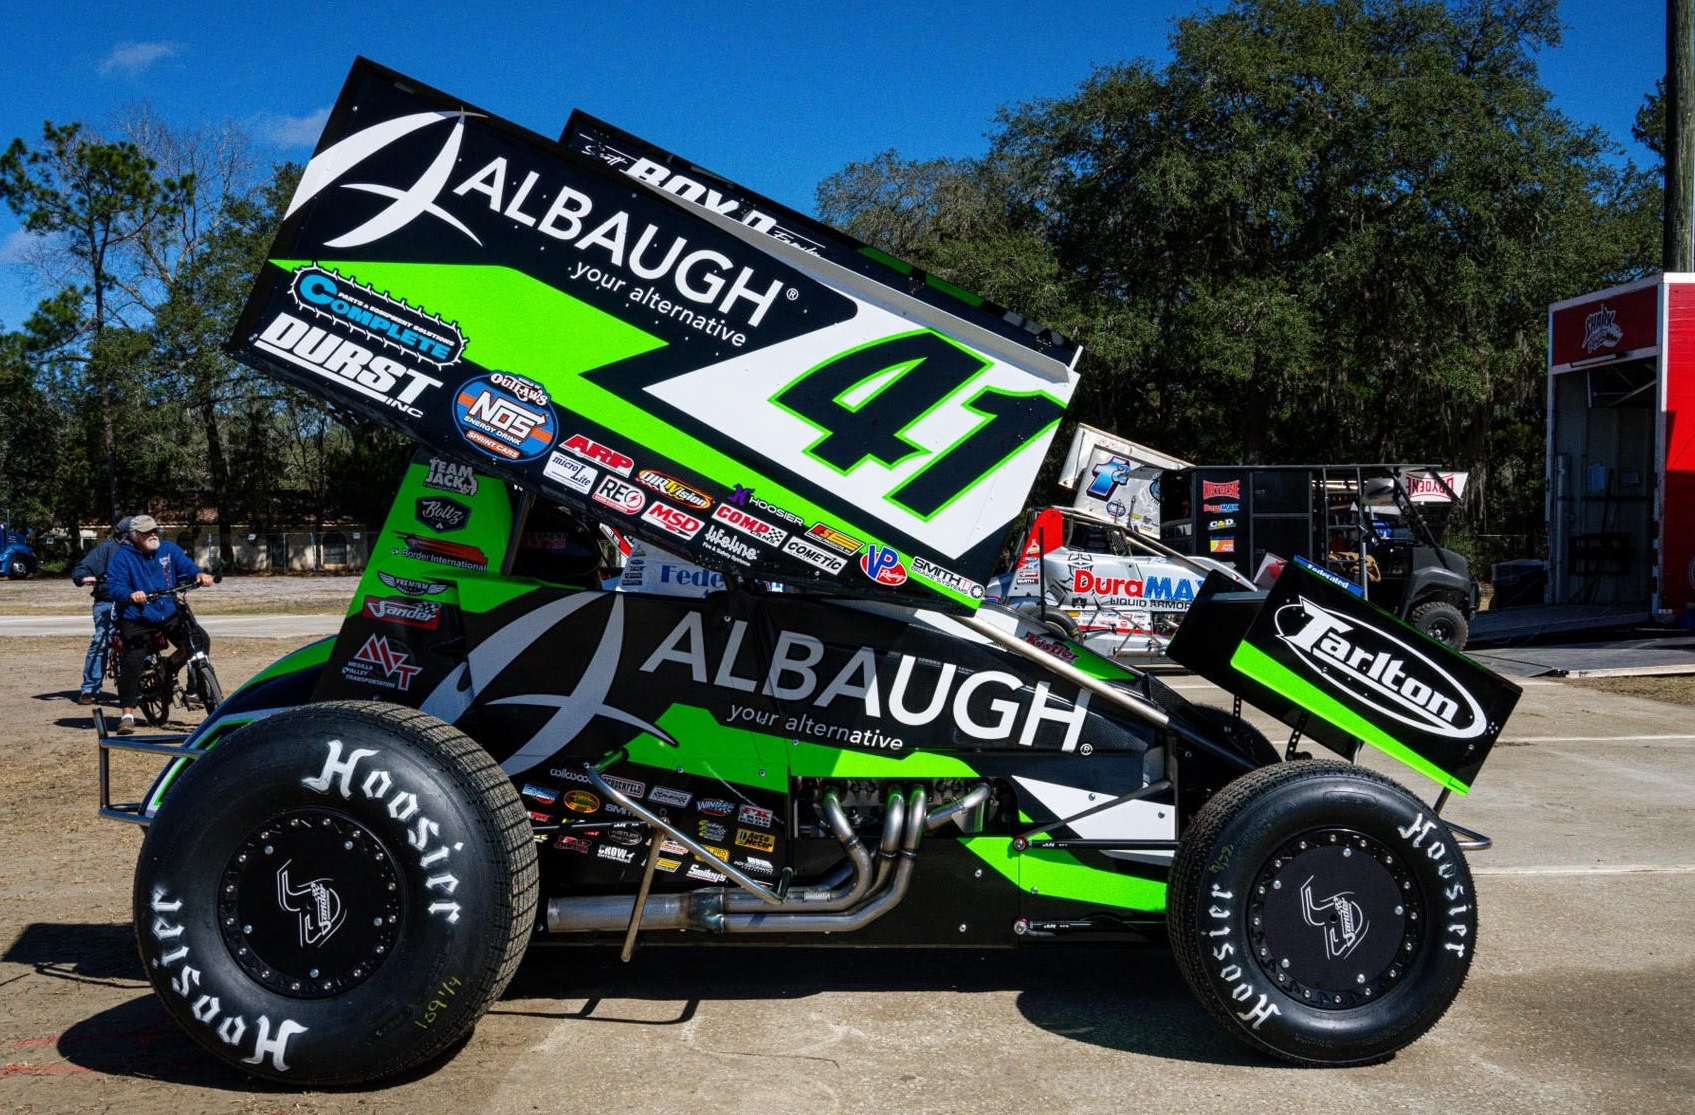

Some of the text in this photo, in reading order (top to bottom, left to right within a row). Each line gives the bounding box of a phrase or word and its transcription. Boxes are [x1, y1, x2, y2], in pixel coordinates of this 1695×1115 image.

[453, 156, 784, 327] ALBAUGH
[300, 274, 452, 360] COMPLETE
[570, 261, 746, 346] your alternative
[413, 324, 455, 346] SOLUTIONS
[259, 312, 443, 408] DURST
[385, 398, 424, 418] INC
[468, 390, 546, 439] NOS
[768, 327, 1068, 522] 41
[464, 416, 521, 445] ENERGY DRINK
[468, 432, 517, 458] SPRINT CARS
[430, 457, 474, 478] TEAM
[563, 435, 633, 469] ARP
[426, 472, 464, 489] JACK
[648, 504, 700, 532] MSD
[716, 505, 770, 534] COMP
[749, 496, 804, 527] HOOSIER
[402, 549, 487, 571] Border International
[867, 544, 899, 580] VP
[879, 568, 905, 583] Racing
[1110, 597, 1147, 608] LIQUID
[345, 667, 368, 677] ALLEY
[1284, 598, 1462, 723] Tarlton
[639, 610, 1093, 752] ALBAUGH
[727, 704, 903, 751] your alternative
[550, 768, 591, 784] wilwoo
[301, 739, 465, 924] Hoosier
[1398, 813, 1468, 958] Hoosier
[1203, 883, 1282, 1029] Hoosier
[150, 884, 310, 1072] Hoosier
